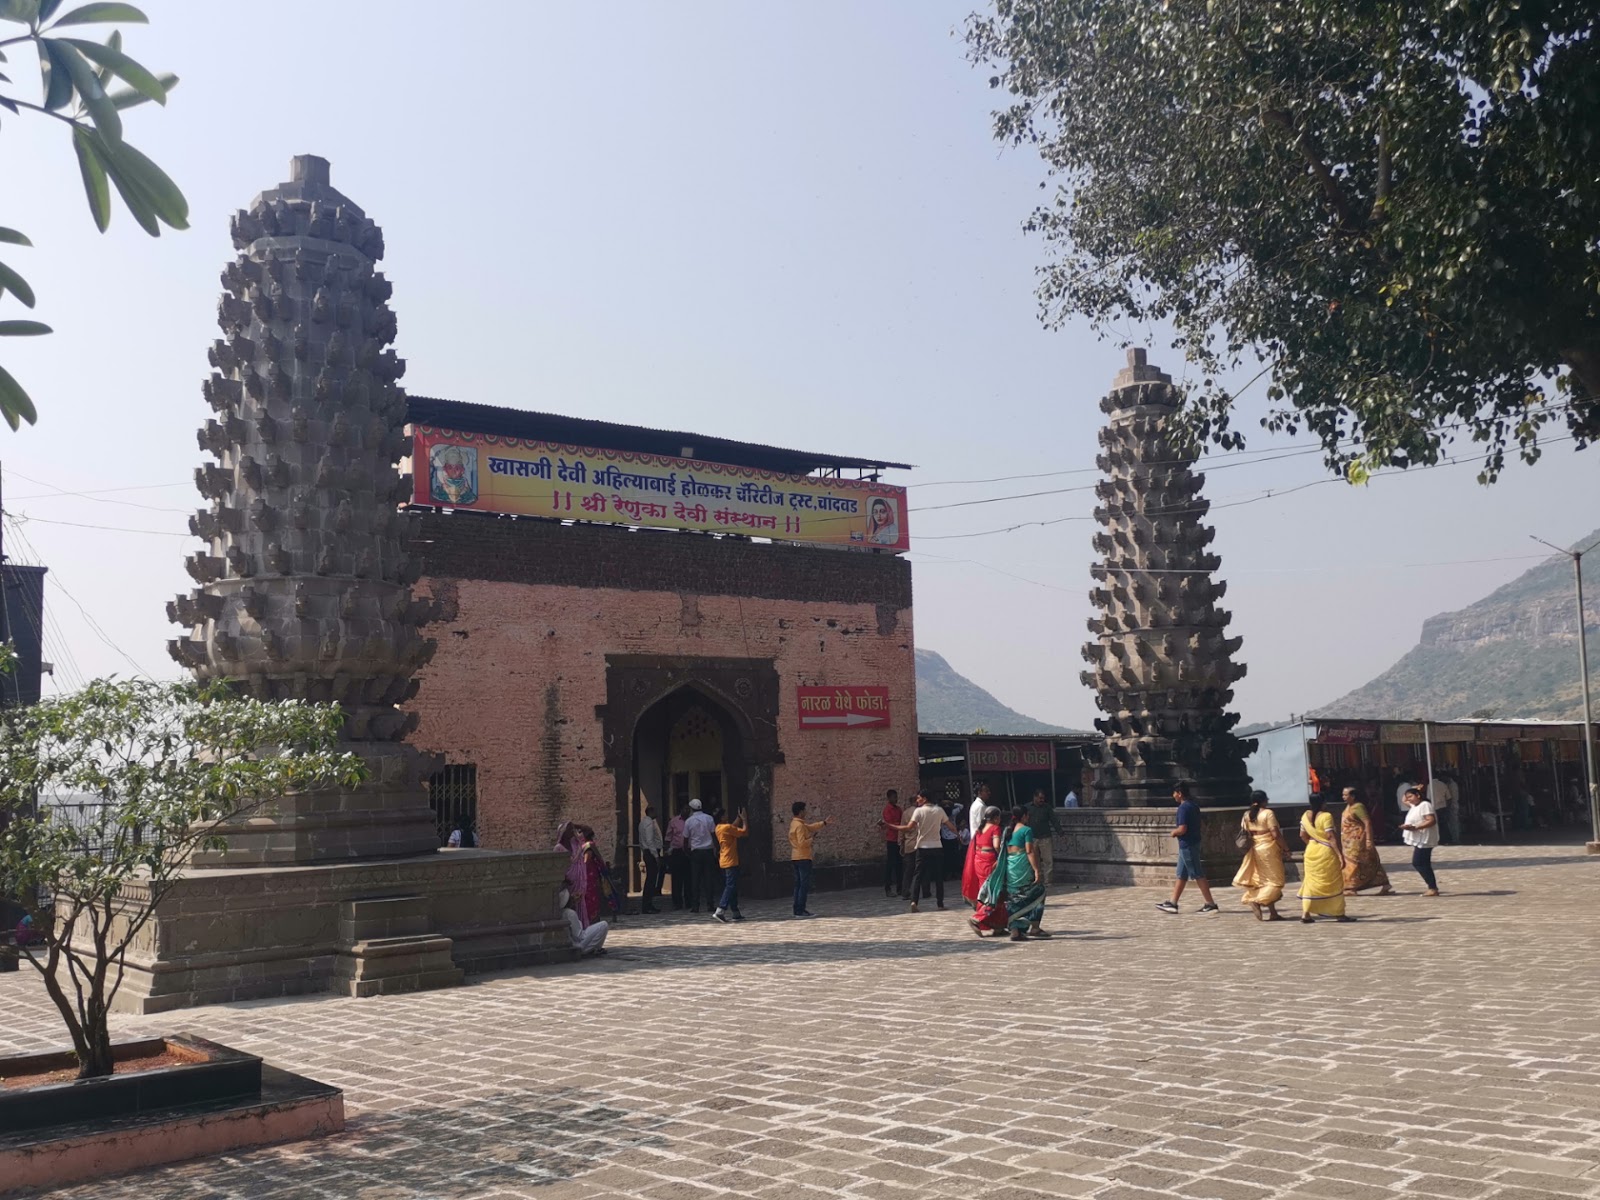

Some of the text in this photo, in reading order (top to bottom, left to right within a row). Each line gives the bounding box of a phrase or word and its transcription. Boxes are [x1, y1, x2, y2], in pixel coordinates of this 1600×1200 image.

[488, 456, 552, 480] खासगी
[557, 458, 587, 484] देवी
[592, 465, 677, 496] अहिल्याबाई
[680, 474, 732, 501] होळकर
[580, 491, 608, 514] श्री
[611, 493, 667, 520] रेणुका
[673, 500, 708, 524] देवी
[713, 506, 777, 530] संस्थान
[800, 695, 832, 711] नारळ
[834, 689, 853, 711] येथे
